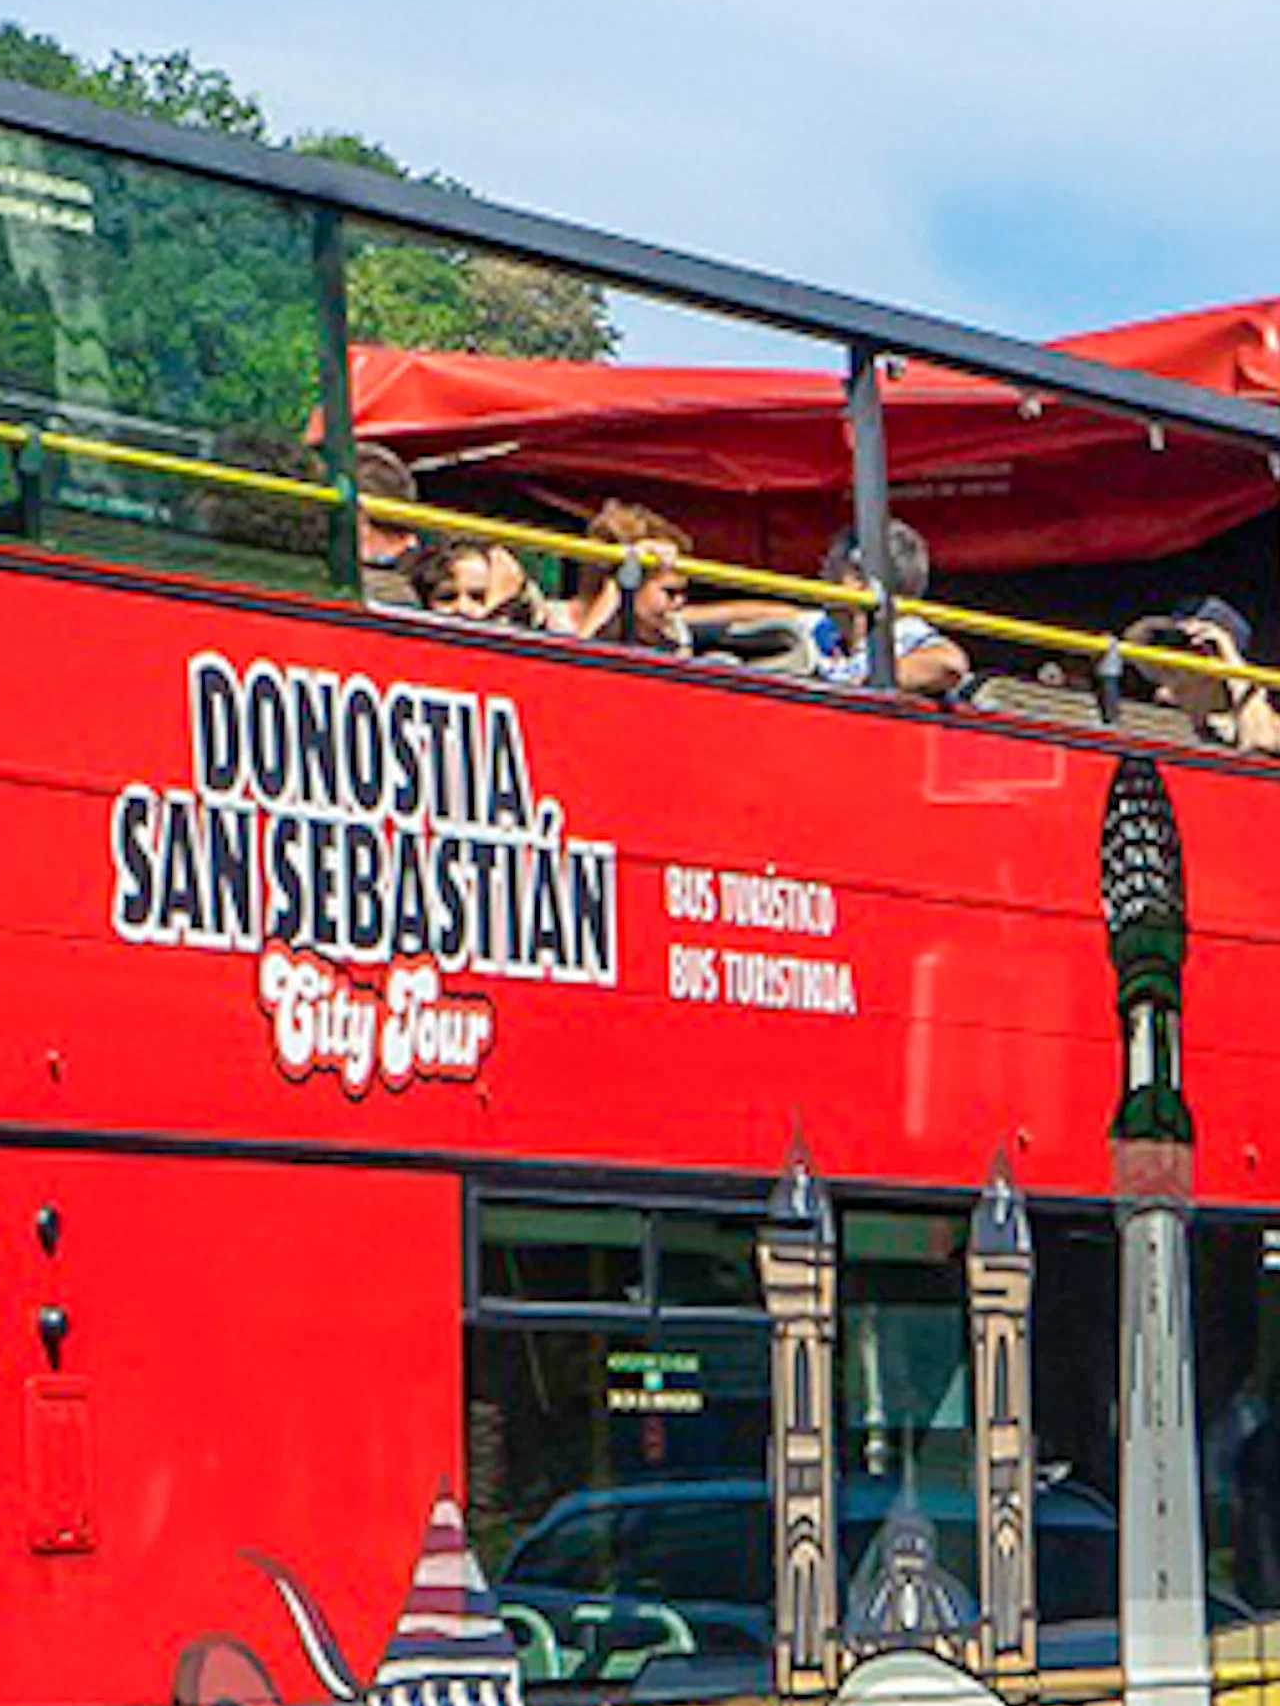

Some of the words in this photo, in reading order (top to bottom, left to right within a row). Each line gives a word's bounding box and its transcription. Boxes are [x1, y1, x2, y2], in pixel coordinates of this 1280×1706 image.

[191, 655, 531, 832] DONOSTIA
[118, 792, 256, 940] SAN
[268, 803, 613, 975] SEBASTIÁN
[664, 864, 718, 923] BUS
[260, 950, 376, 1084] City
[381, 965, 490, 1077] Tour
[667, 943, 719, 1003] BUS
